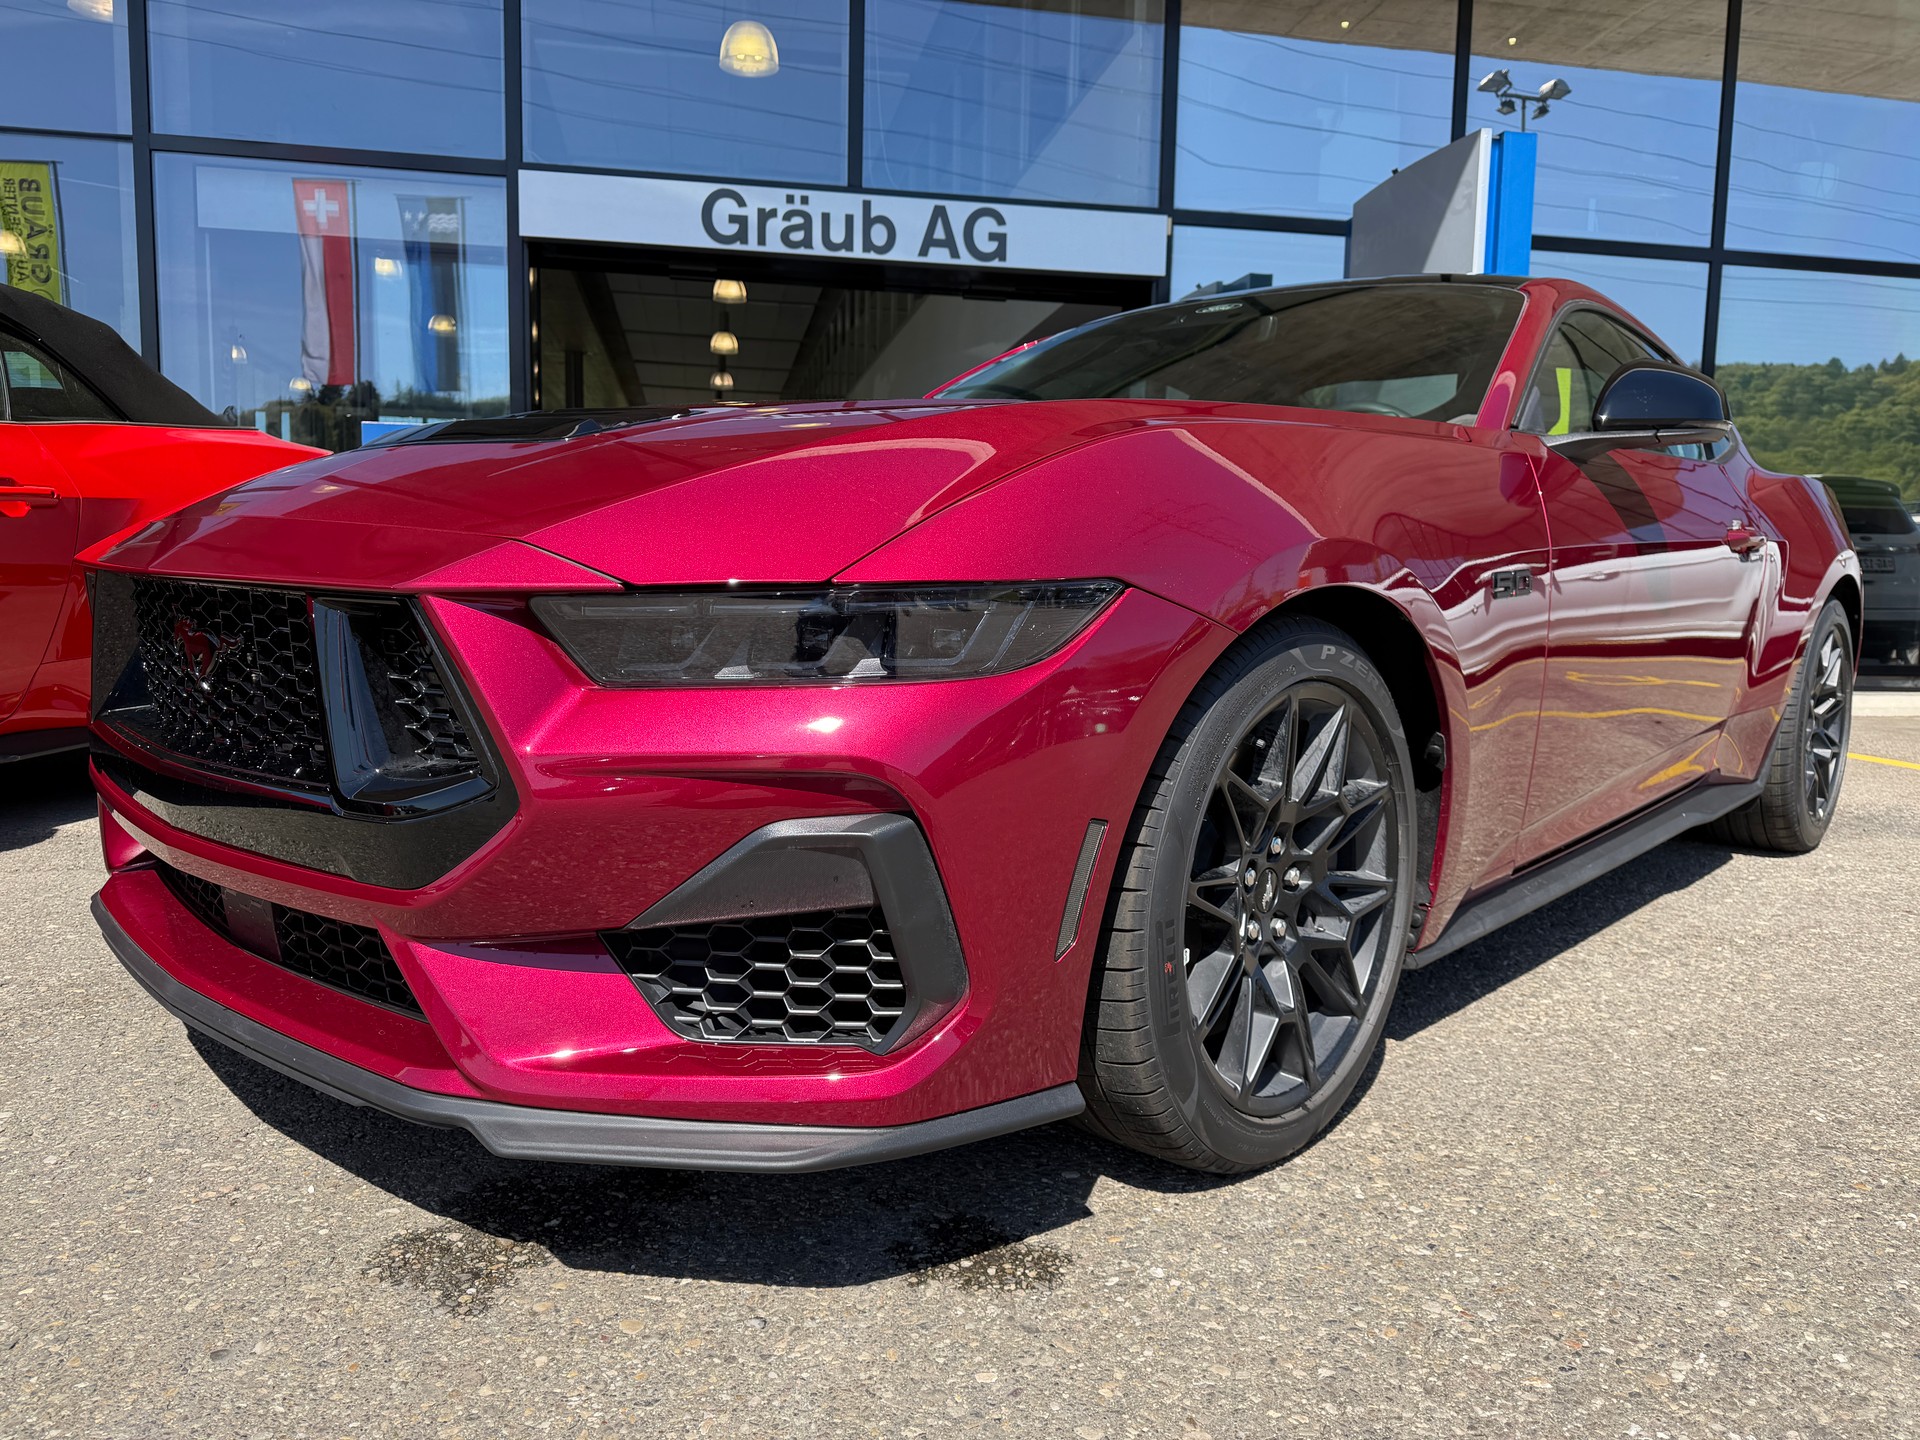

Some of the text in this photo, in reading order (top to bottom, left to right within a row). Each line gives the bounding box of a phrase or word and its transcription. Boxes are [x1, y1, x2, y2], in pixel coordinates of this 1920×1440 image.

[701, 188, 1008, 262] Gräub AG
[1320, 644, 1337, 660] P
